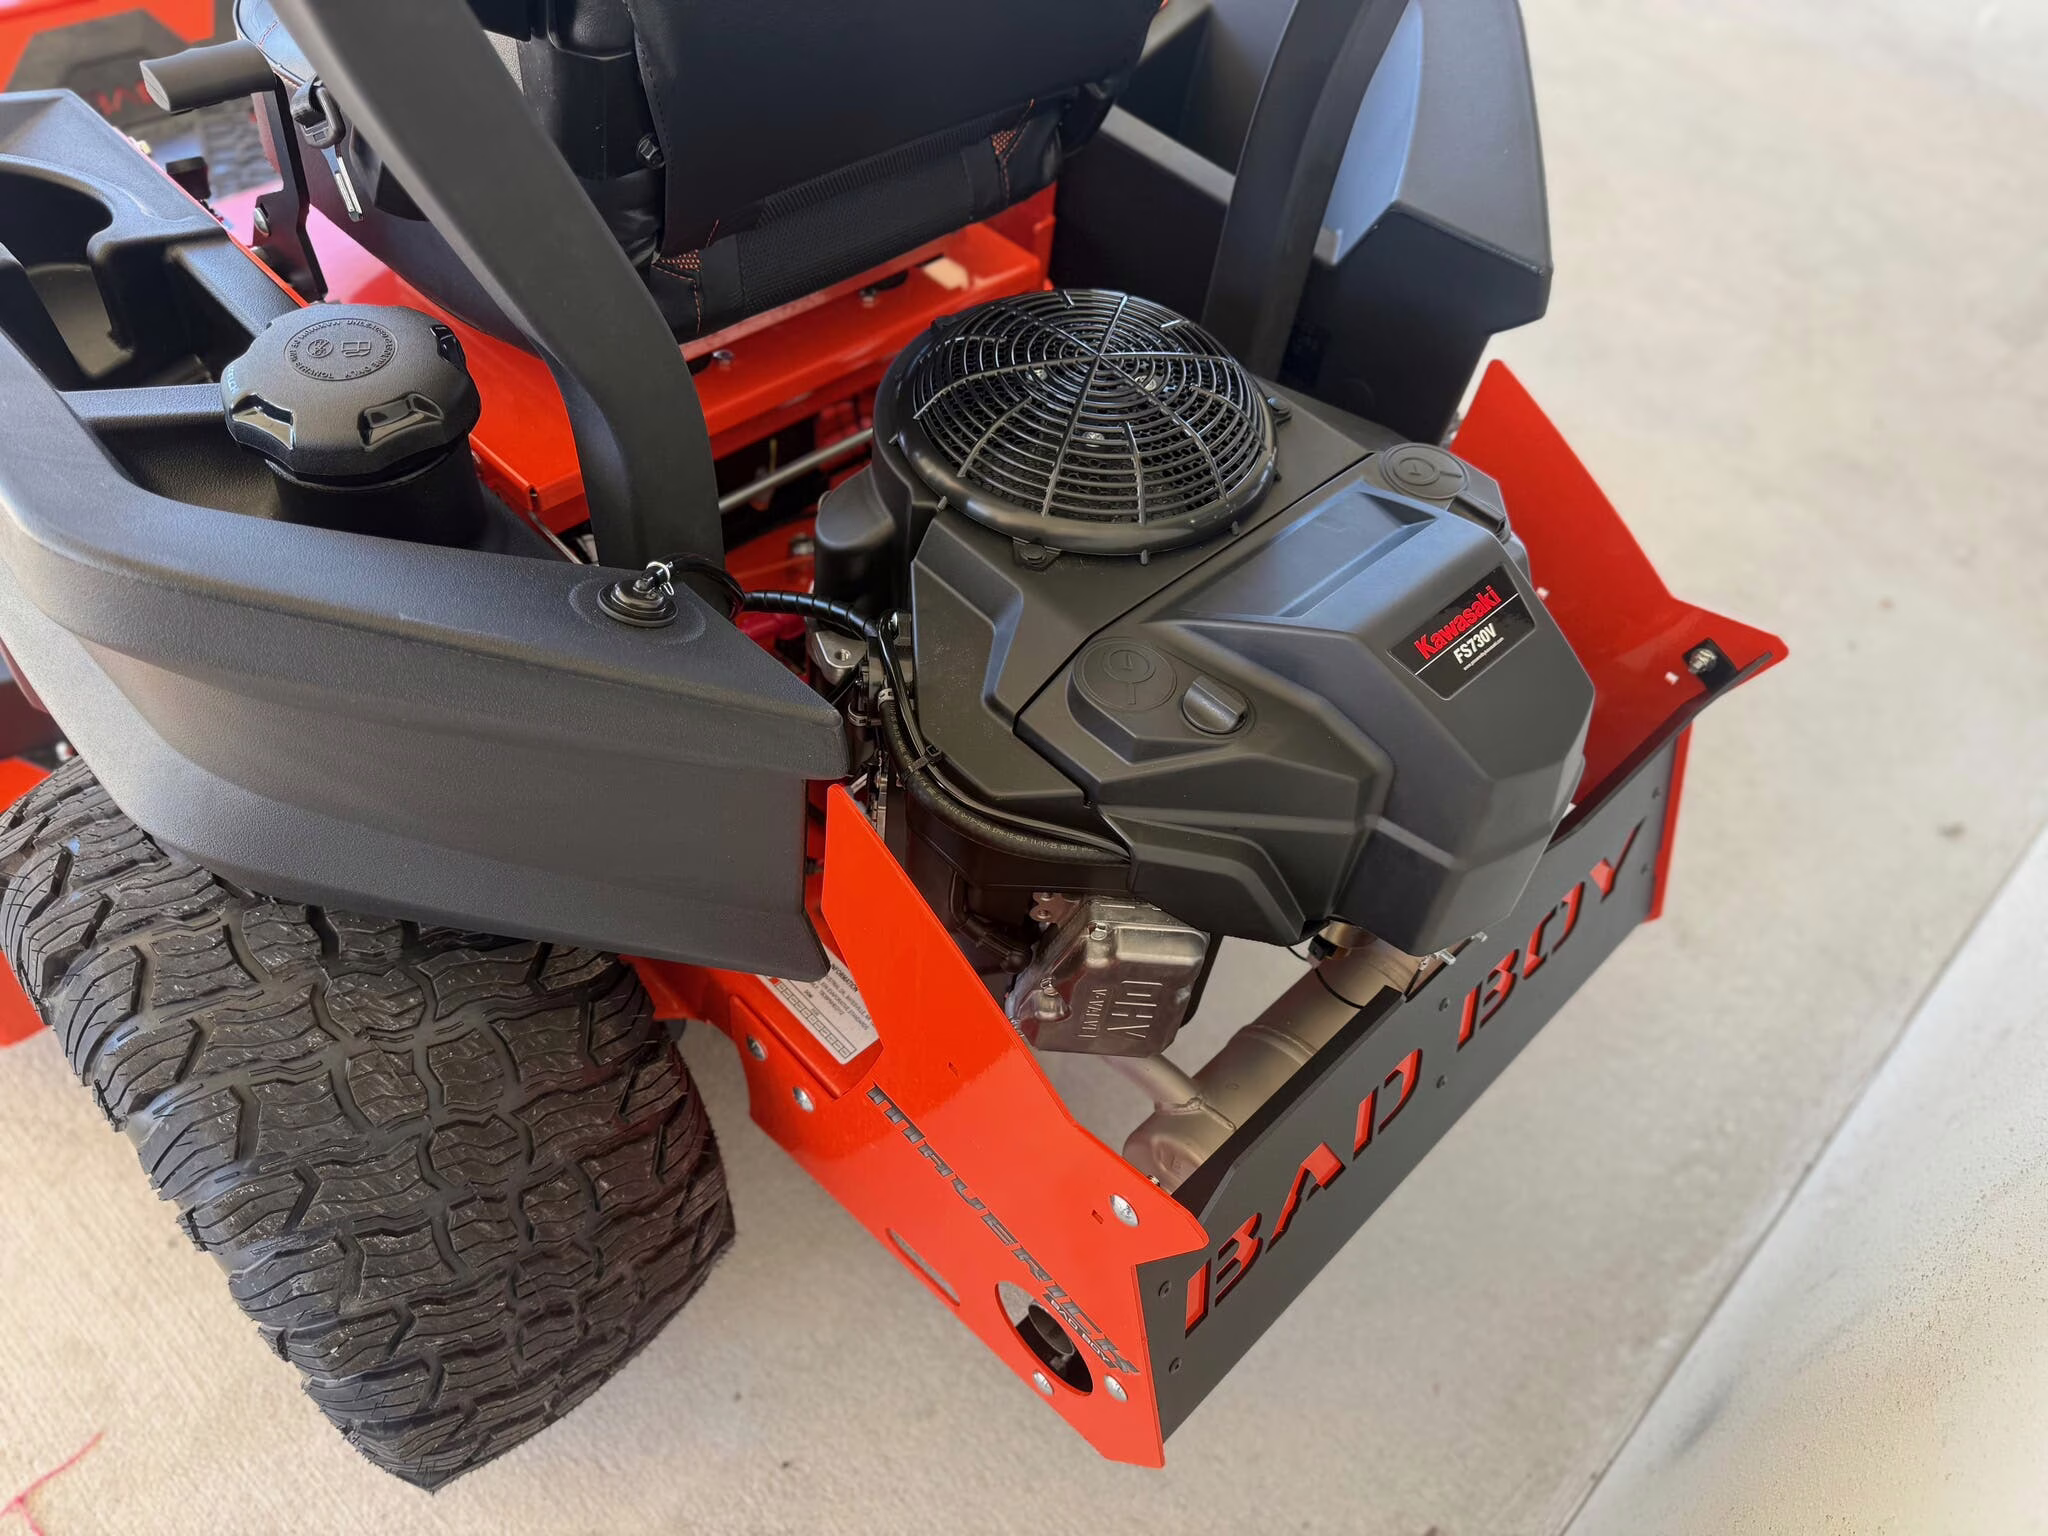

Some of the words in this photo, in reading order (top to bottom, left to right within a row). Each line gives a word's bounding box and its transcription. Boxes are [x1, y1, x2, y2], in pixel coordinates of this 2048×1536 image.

[1414, 584, 1502, 660] Kawasaki
[1453, 622, 1498, 664] FS730V
[1185, 1048, 1423, 1338] BAD
[1457, 817, 1647, 1052] BOY
[866, 1081, 1140, 1374] MAVERICK
[1050, 1299, 1079, 1331] BAD
[1081, 1332, 1110, 1363] BOY
